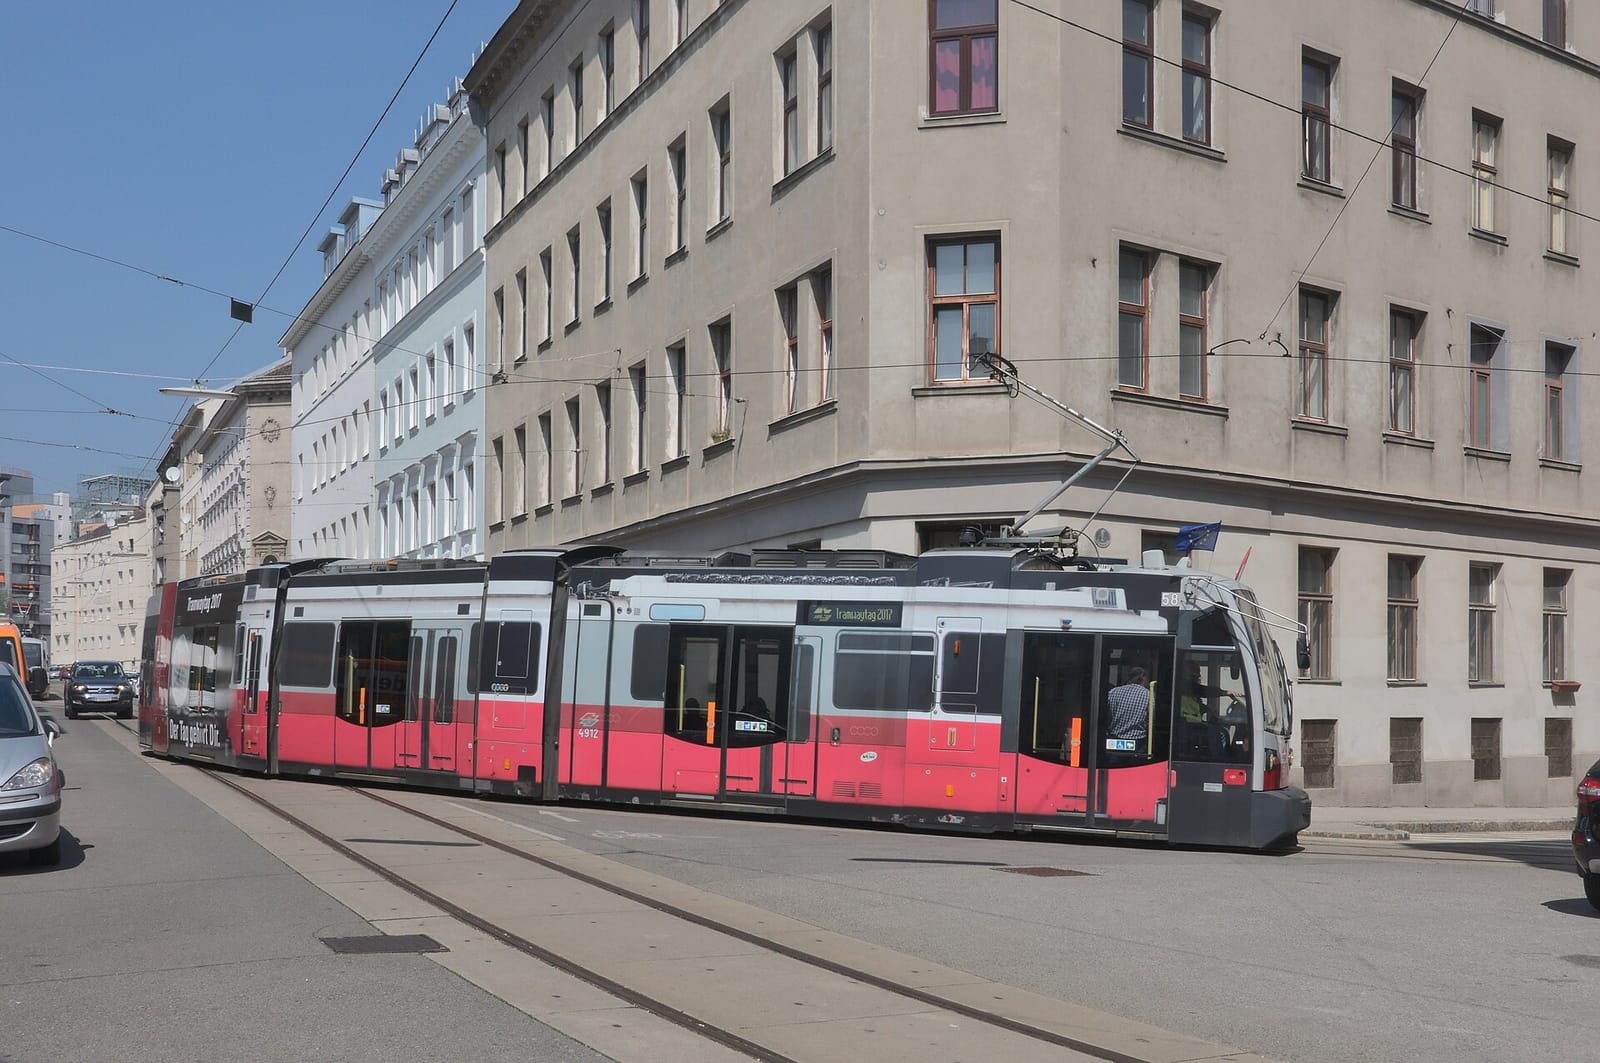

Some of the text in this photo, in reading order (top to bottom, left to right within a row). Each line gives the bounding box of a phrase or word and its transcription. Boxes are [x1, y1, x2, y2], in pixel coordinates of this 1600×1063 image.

[1161, 592, 1178, 607] 58
[836, 607, 893, 622] Tramwaytag 2017
[179, 720, 189, 747] Tag
[578, 728, 599, 739] 4912
